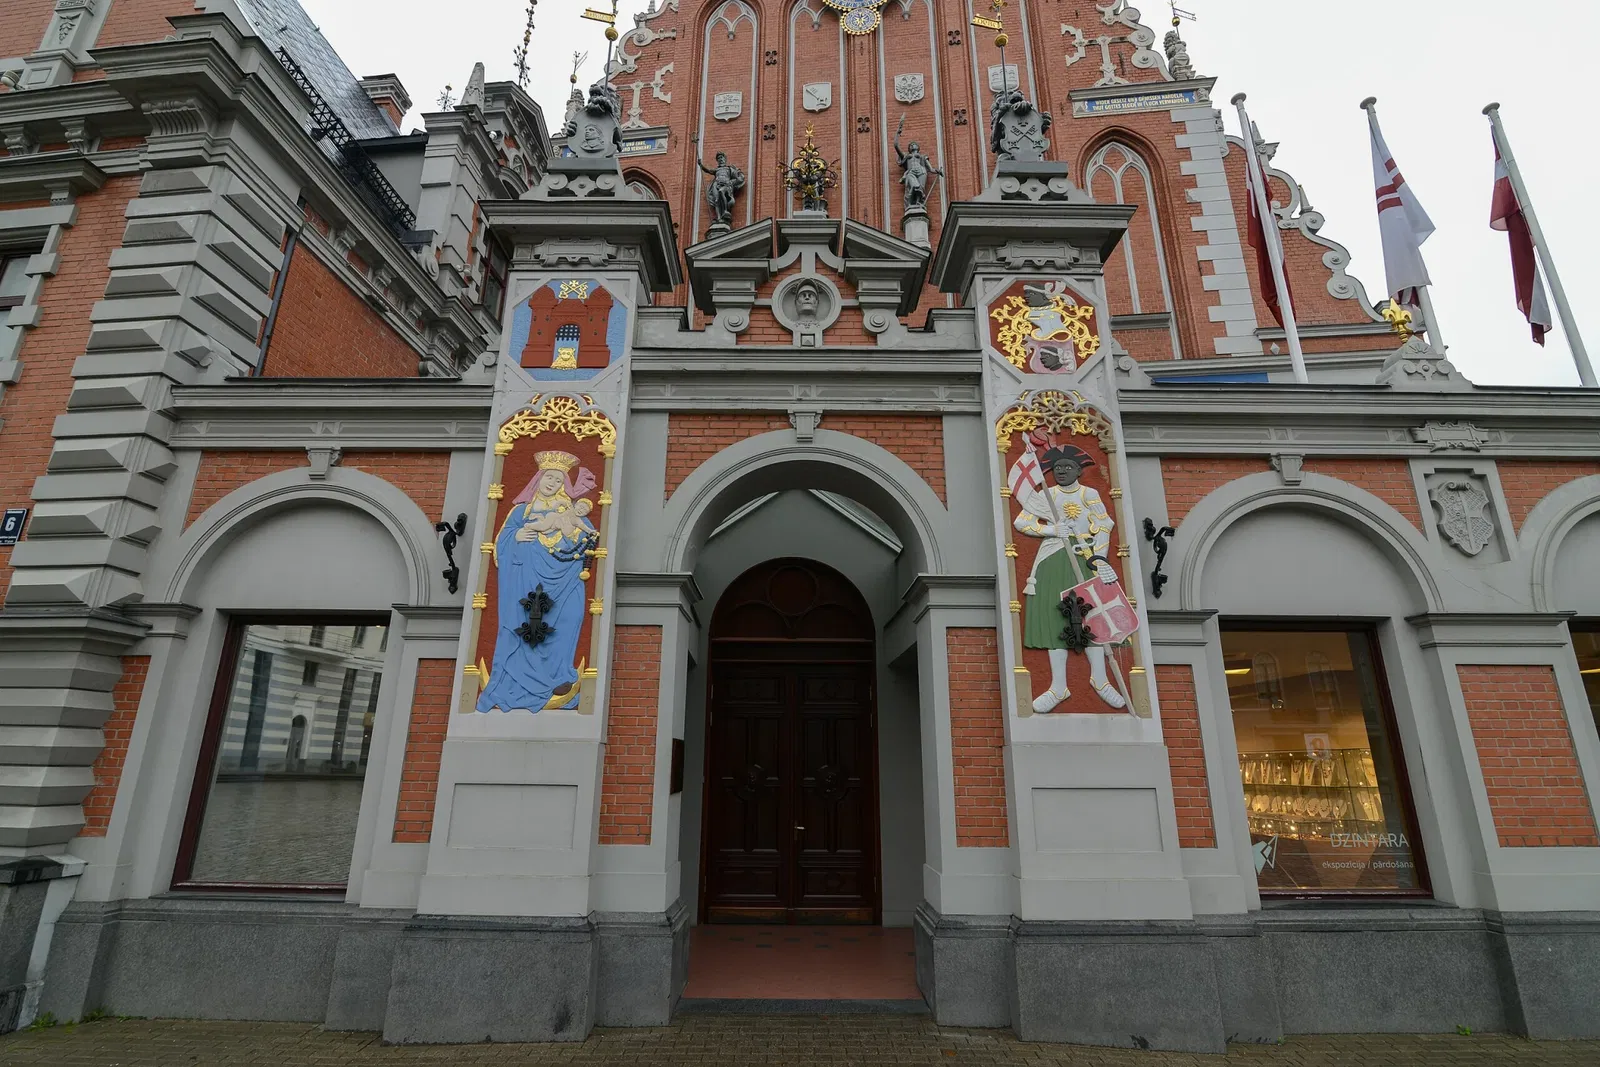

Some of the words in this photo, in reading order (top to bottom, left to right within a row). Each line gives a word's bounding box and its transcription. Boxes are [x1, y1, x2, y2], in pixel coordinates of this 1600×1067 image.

[5, 516, 16, 531] 6
[1330, 833, 1410, 848] DZINTARA
[1373, 860, 1414, 870] pārdošana
